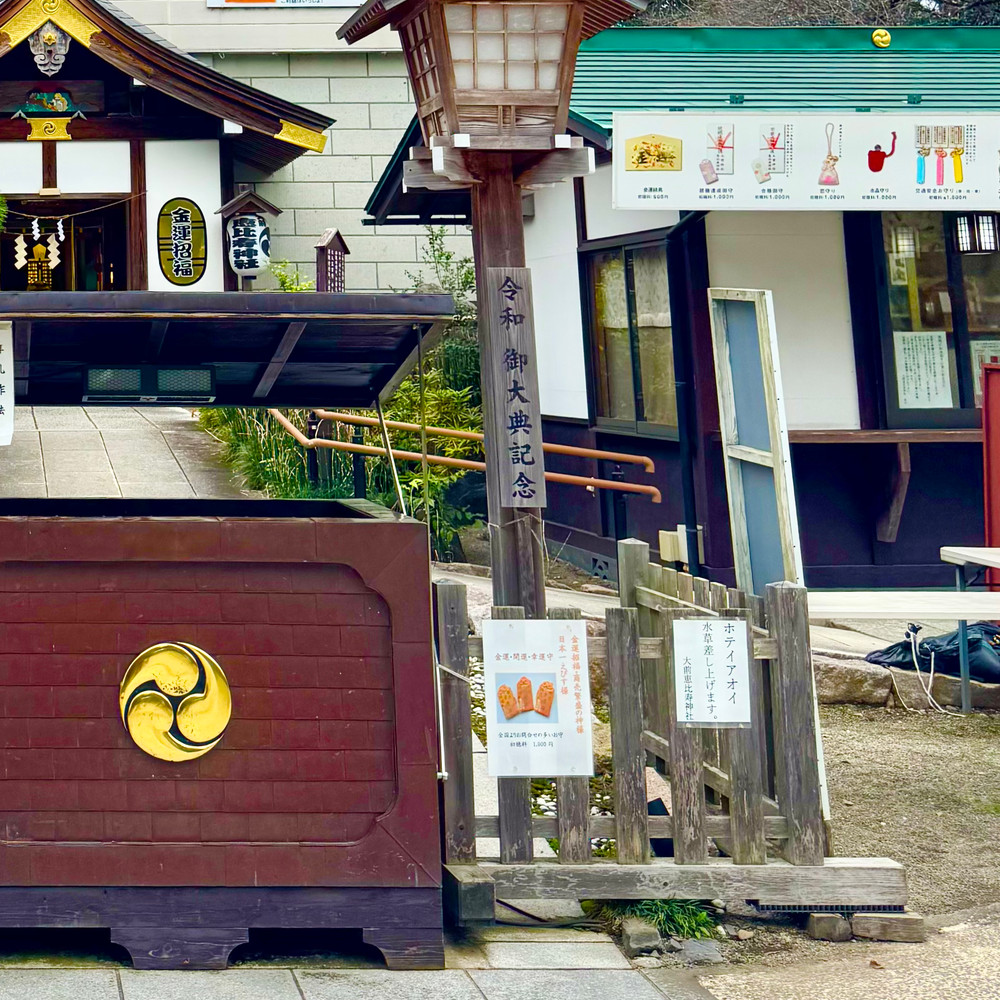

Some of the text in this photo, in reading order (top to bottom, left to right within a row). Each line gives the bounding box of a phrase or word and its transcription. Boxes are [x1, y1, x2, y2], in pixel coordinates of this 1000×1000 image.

[171, 207, 193, 277] 金運招福
[558, 635, 568, 695] 日本一えびす様
[683, 656, 694, 721] 大前恵比寿神社
[702, 622, 718, 720] 水草差し上げます。
[724, 623, 738, 704] ホテイアオイ
